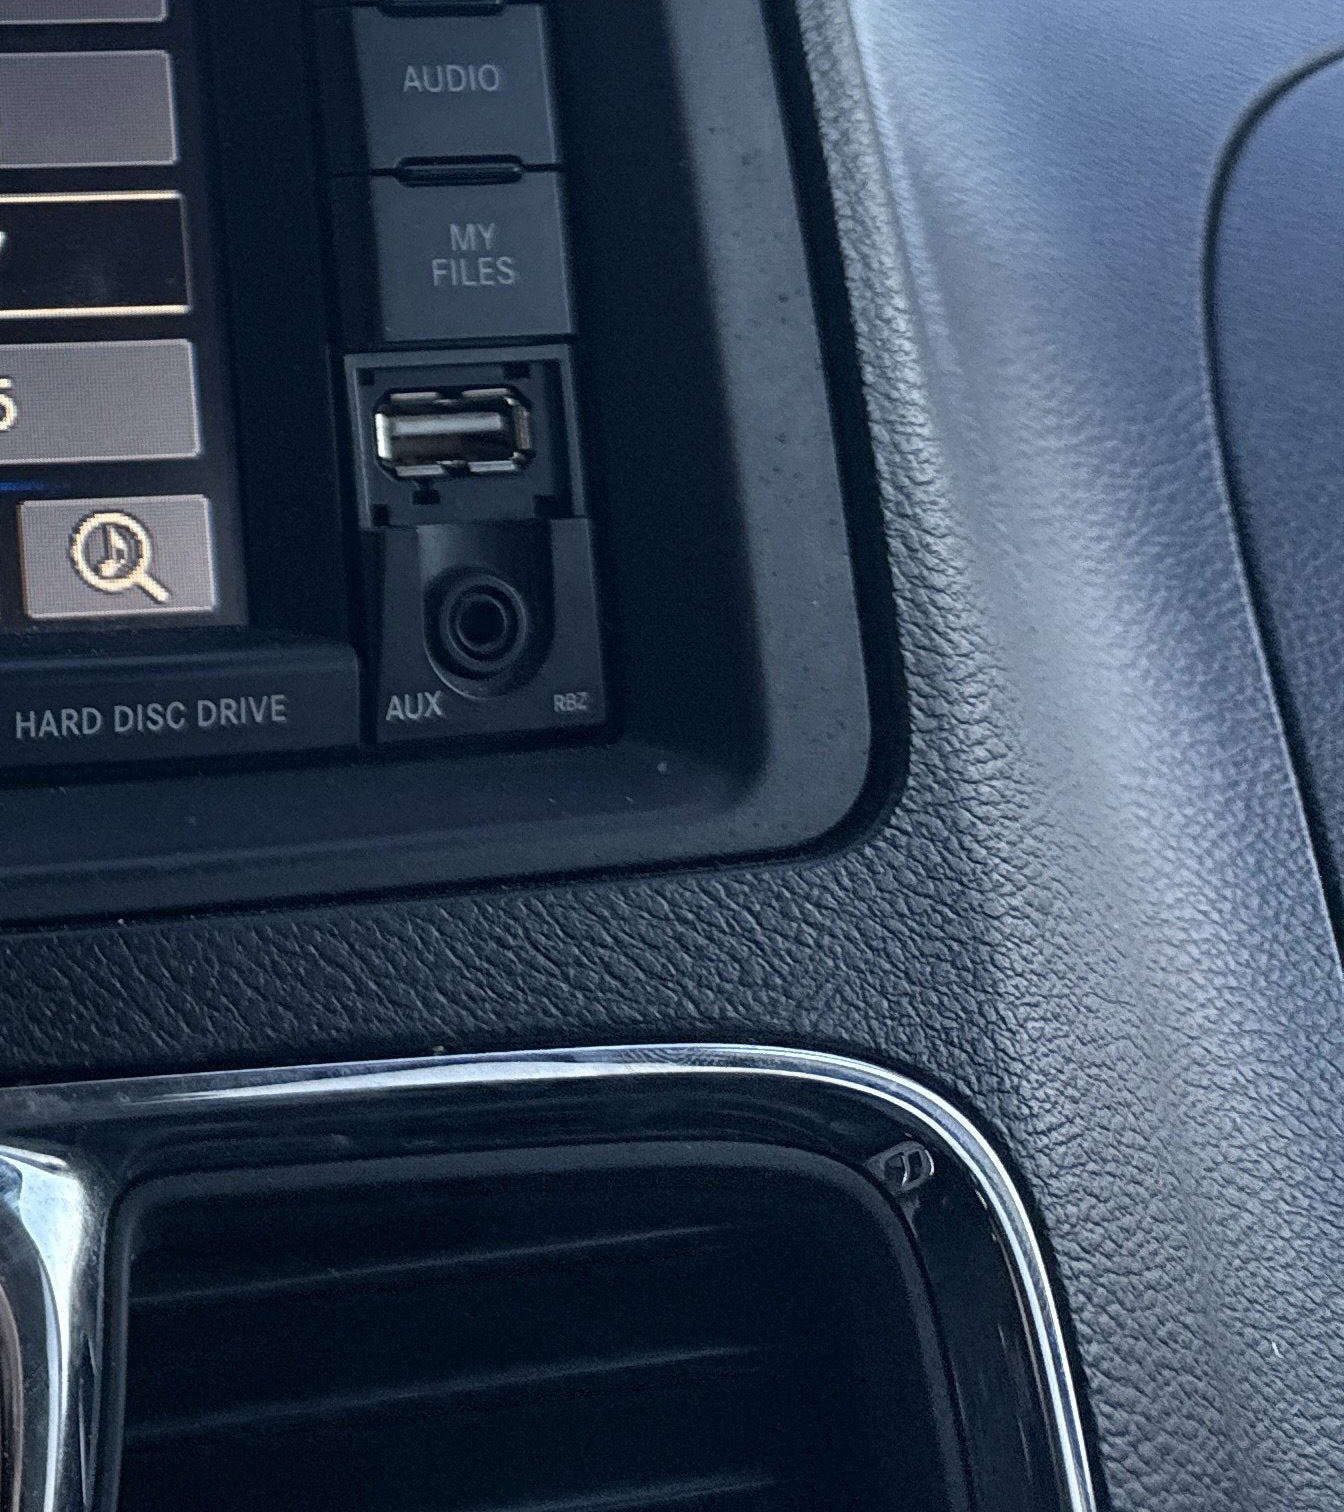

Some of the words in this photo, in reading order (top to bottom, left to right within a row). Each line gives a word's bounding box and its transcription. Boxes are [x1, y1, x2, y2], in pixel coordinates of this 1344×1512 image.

[403, 64, 500, 92] AUDIO
[450, 222, 496, 251] MY
[431, 256, 515, 287] FILES
[15, 707, 102, 740] HARD
[112, 701, 186, 734] DISC
[196, 694, 288, 728] DRIVE
[385, 690, 444, 721] AUX
